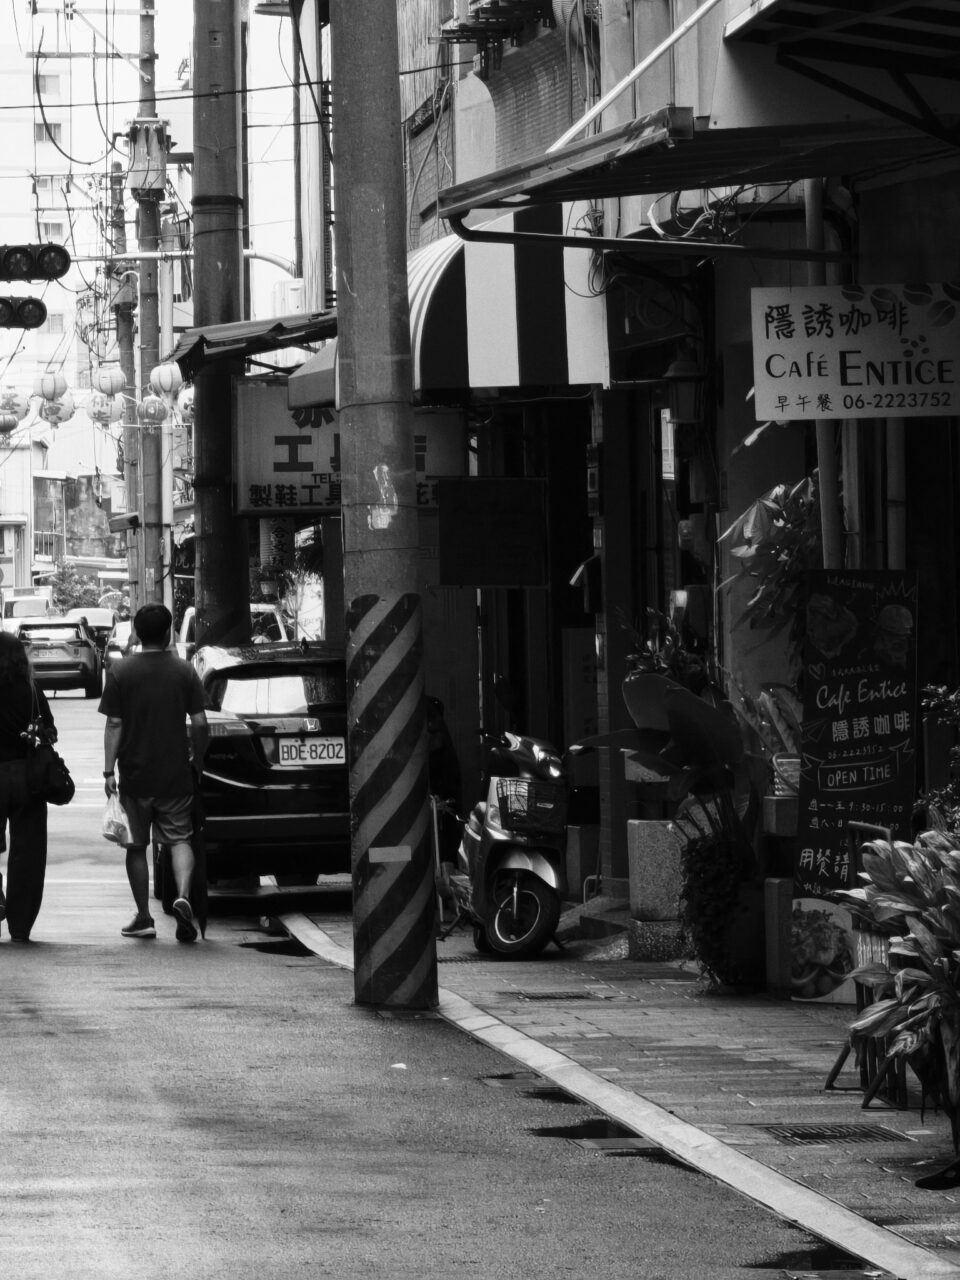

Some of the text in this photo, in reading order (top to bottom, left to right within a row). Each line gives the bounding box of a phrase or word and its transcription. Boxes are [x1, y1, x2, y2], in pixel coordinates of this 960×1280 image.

[764, 301, 910, 340] 隱誘咖啡
[774, 392, 952, 414] 早午餐 06-2223752
[815, 683, 852, 715] Cafe
[831, 709, 911, 743] 隱誘咖啡
[281, 743, 344, 761] BDE-8202
[826, 763, 892, 787] OPEN TIME
